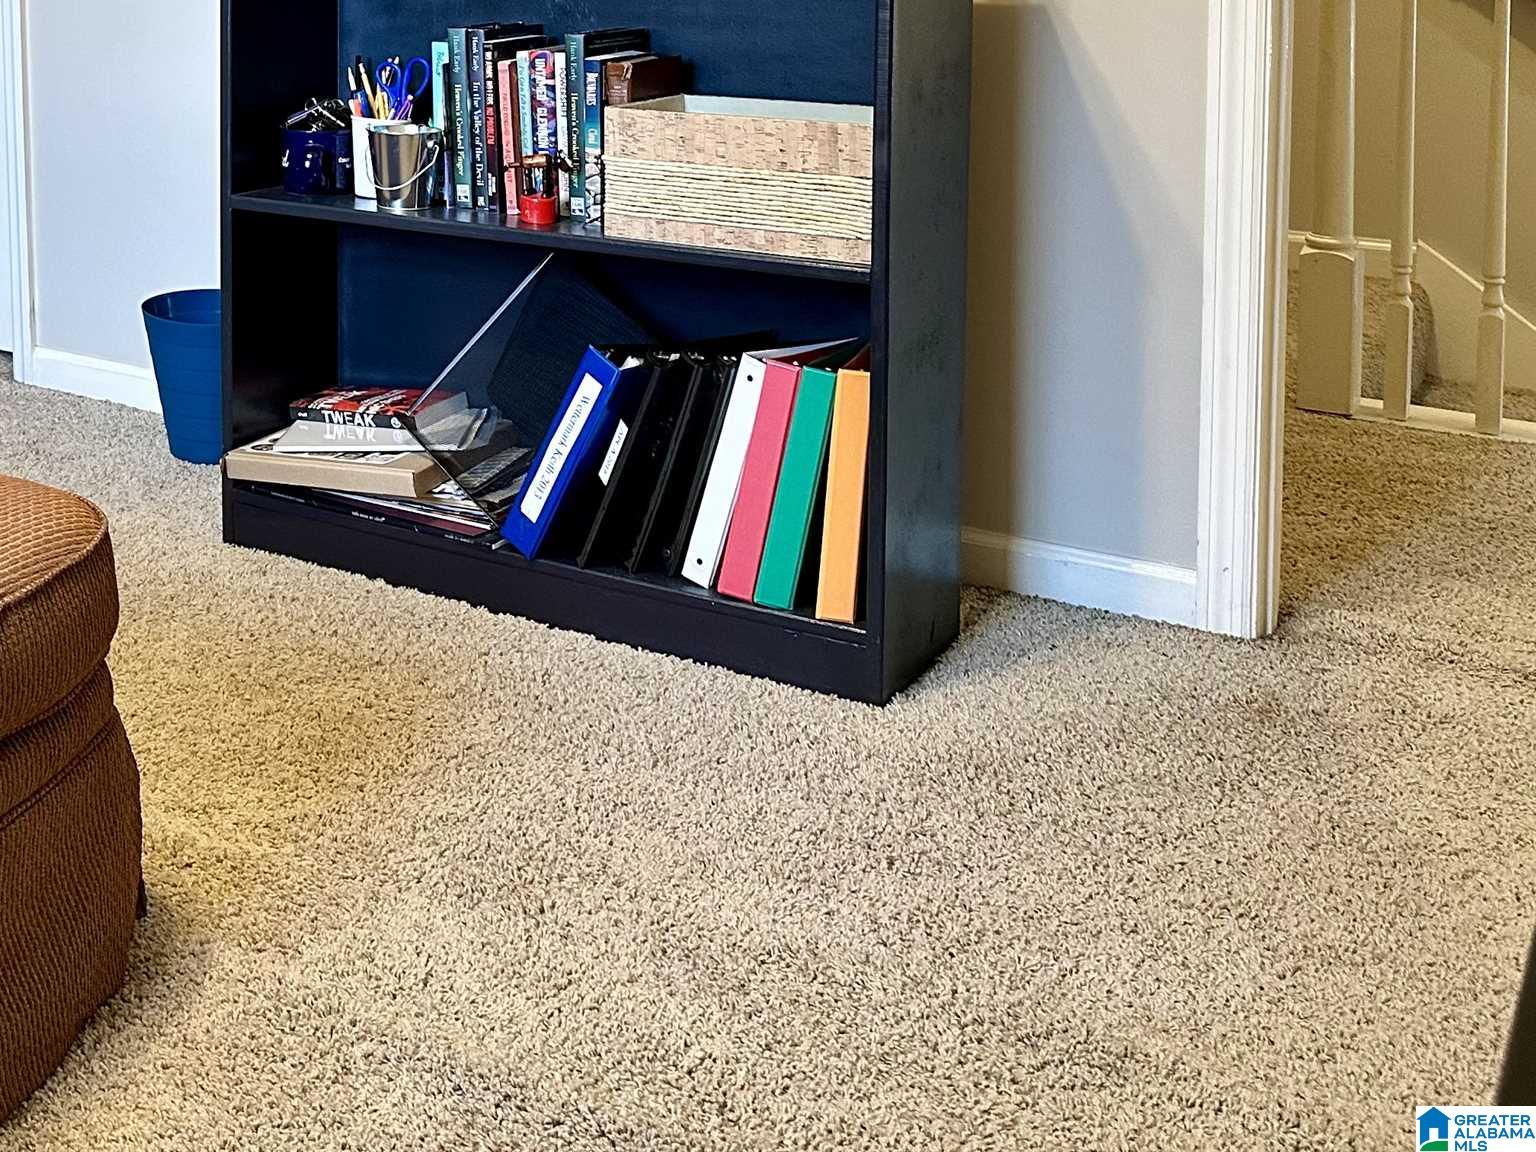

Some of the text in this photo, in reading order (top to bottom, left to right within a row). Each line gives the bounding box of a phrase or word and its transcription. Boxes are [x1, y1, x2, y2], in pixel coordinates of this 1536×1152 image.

[452, 35, 460, 73] Hank Early
[471, 36, 479, 72] Hank Early
[535, 58, 546, 101] UNTAMED
[569, 62, 577, 80] Early
[455, 84, 463, 117] Heaven's
[570, 92, 579, 126] Heaven's
[456, 117, 464, 150] Crooked
[473, 82, 484, 186] In the Valley of the Devil
[486, 116, 496, 145] PROBLEM
[571, 127, 579, 160] Crooked
[455, 151, 464, 176] Finger
[321, 410, 376, 428] TWEAK
